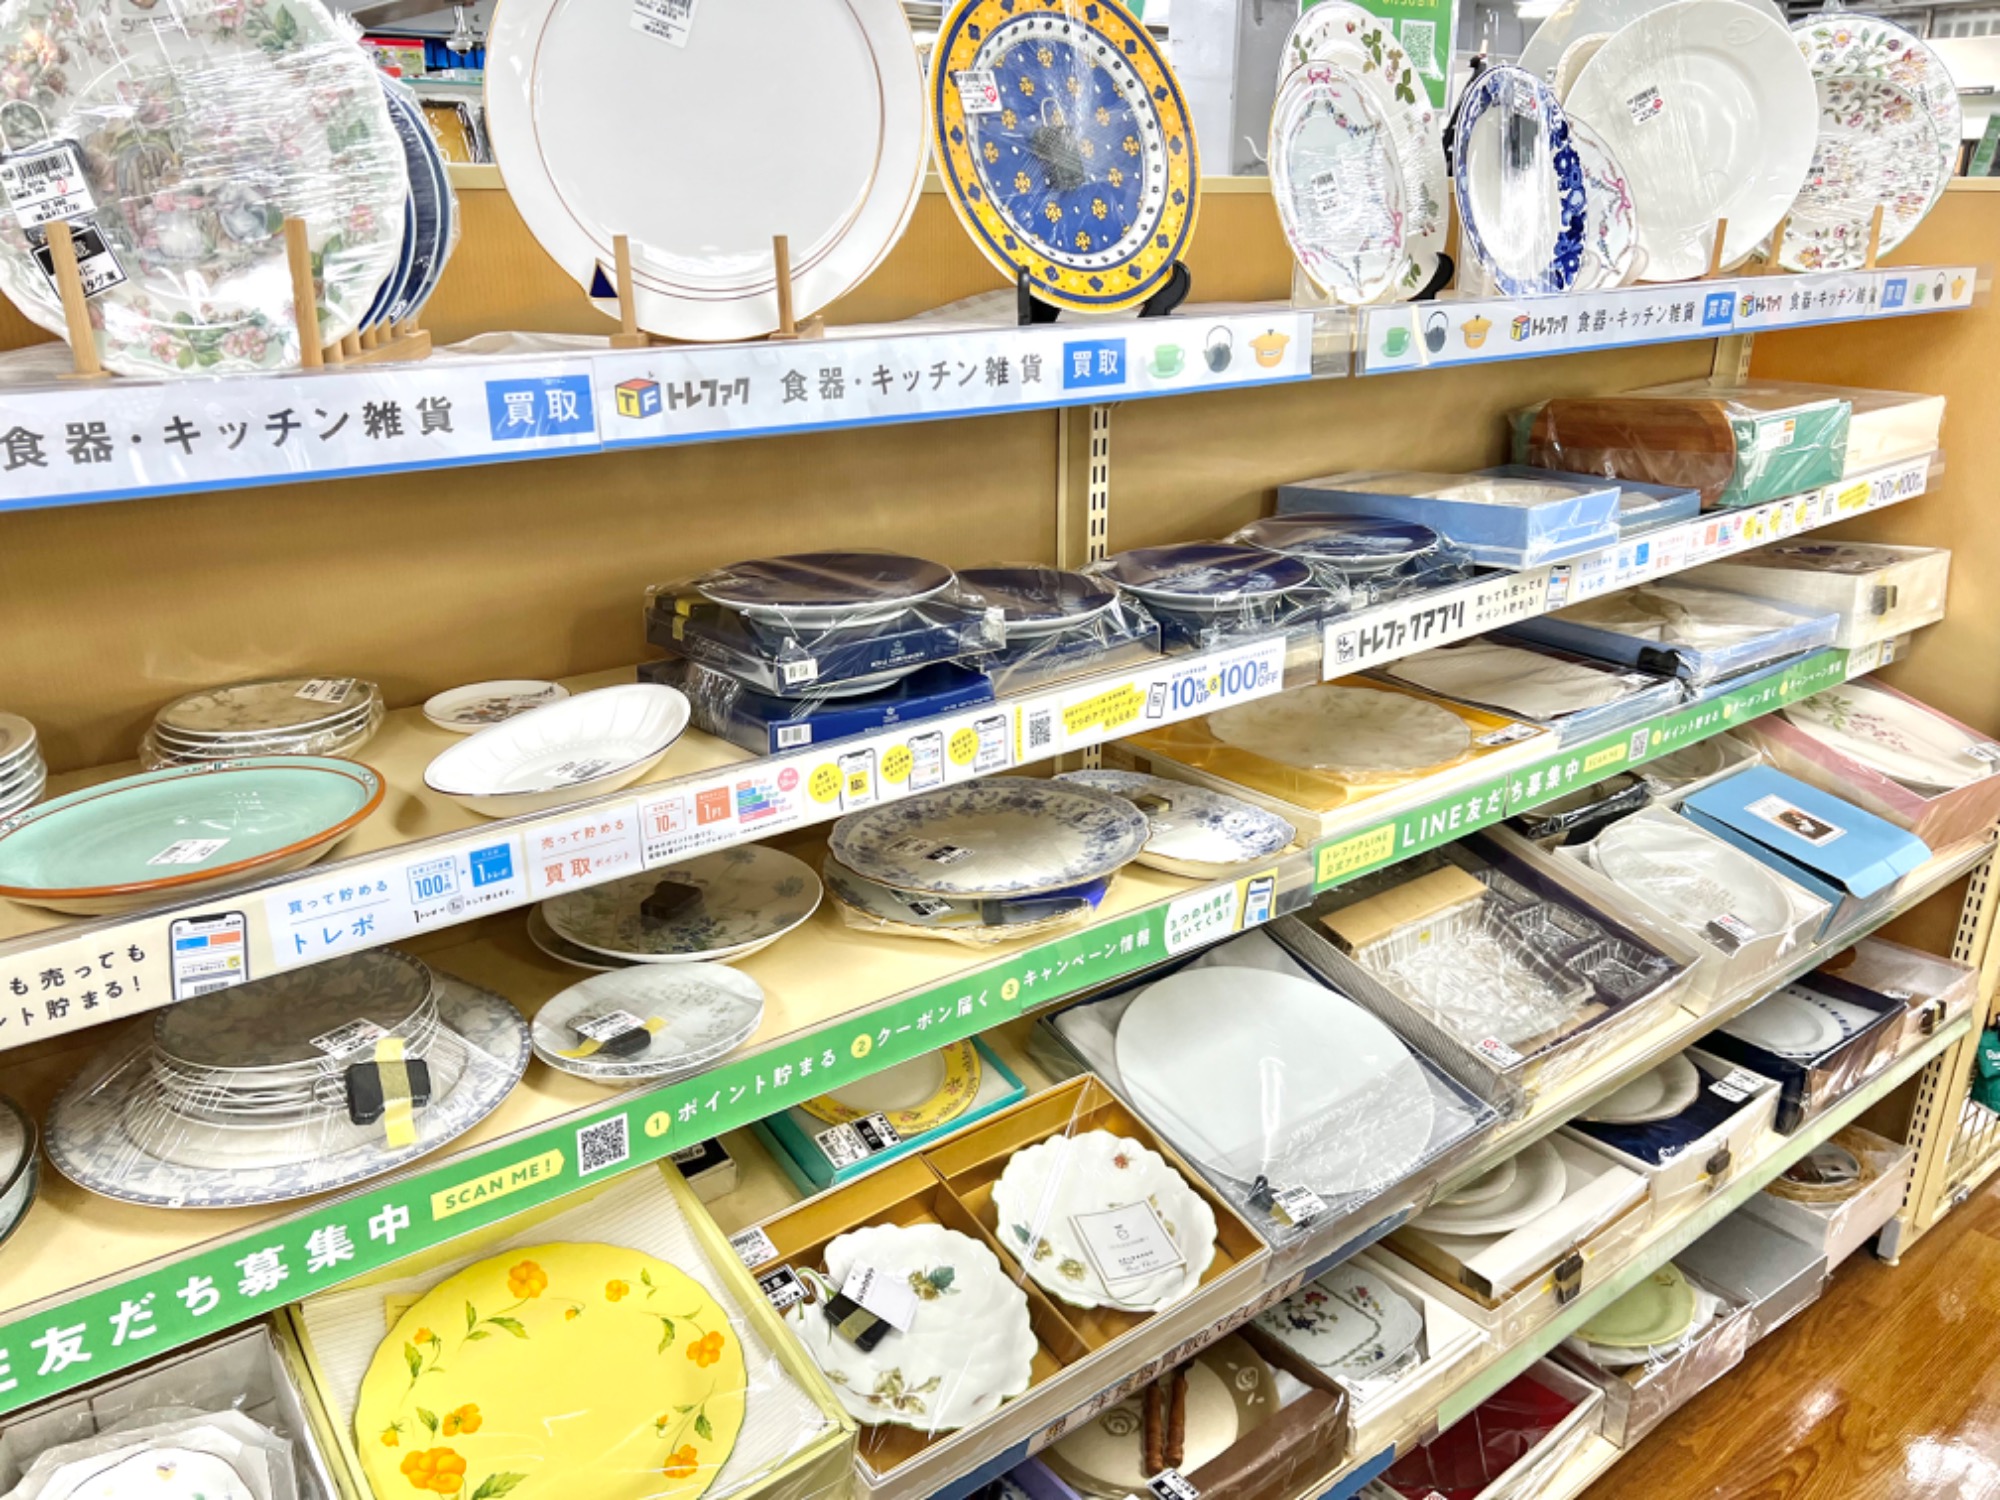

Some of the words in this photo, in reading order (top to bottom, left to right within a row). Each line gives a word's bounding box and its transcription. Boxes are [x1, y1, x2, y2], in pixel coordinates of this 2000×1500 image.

[1531, 314, 1569, 337] トレファク
[1577, 301, 1696, 335] 食器・キッチン雑貨
[1706, 297, 1733, 321] 買取
[667, 377, 750, 412] トレファク
[781, 353, 1044, 404] 食器・キッチン雑貨
[1072, 347, 1119, 379] 買取
[2, 396, 455, 472] 食器・キッチン雑貨
[503, 388, 580, 426] 買取
[1359, 601, 1465, 658] トレファクアプリ
[1171, 677, 1195, 710] 10
[1220, 660, 1257, 697] 100
[1402, 758, 1580, 848] LINE友だち募集中
[541, 820, 625, 849] 売って貯める
[288, 880, 388, 915] 買って貯める
[544, 858, 592, 887] 買取
[294, 914, 375, 955] トレポ
[1024, 928, 1151, 987] キャンペーン情報
[877, 990, 988, 1048] クーポン届く
[678, 1049, 836, 1122] ポイント貯まる
[446, 1177, 503, 1209] SCAN
